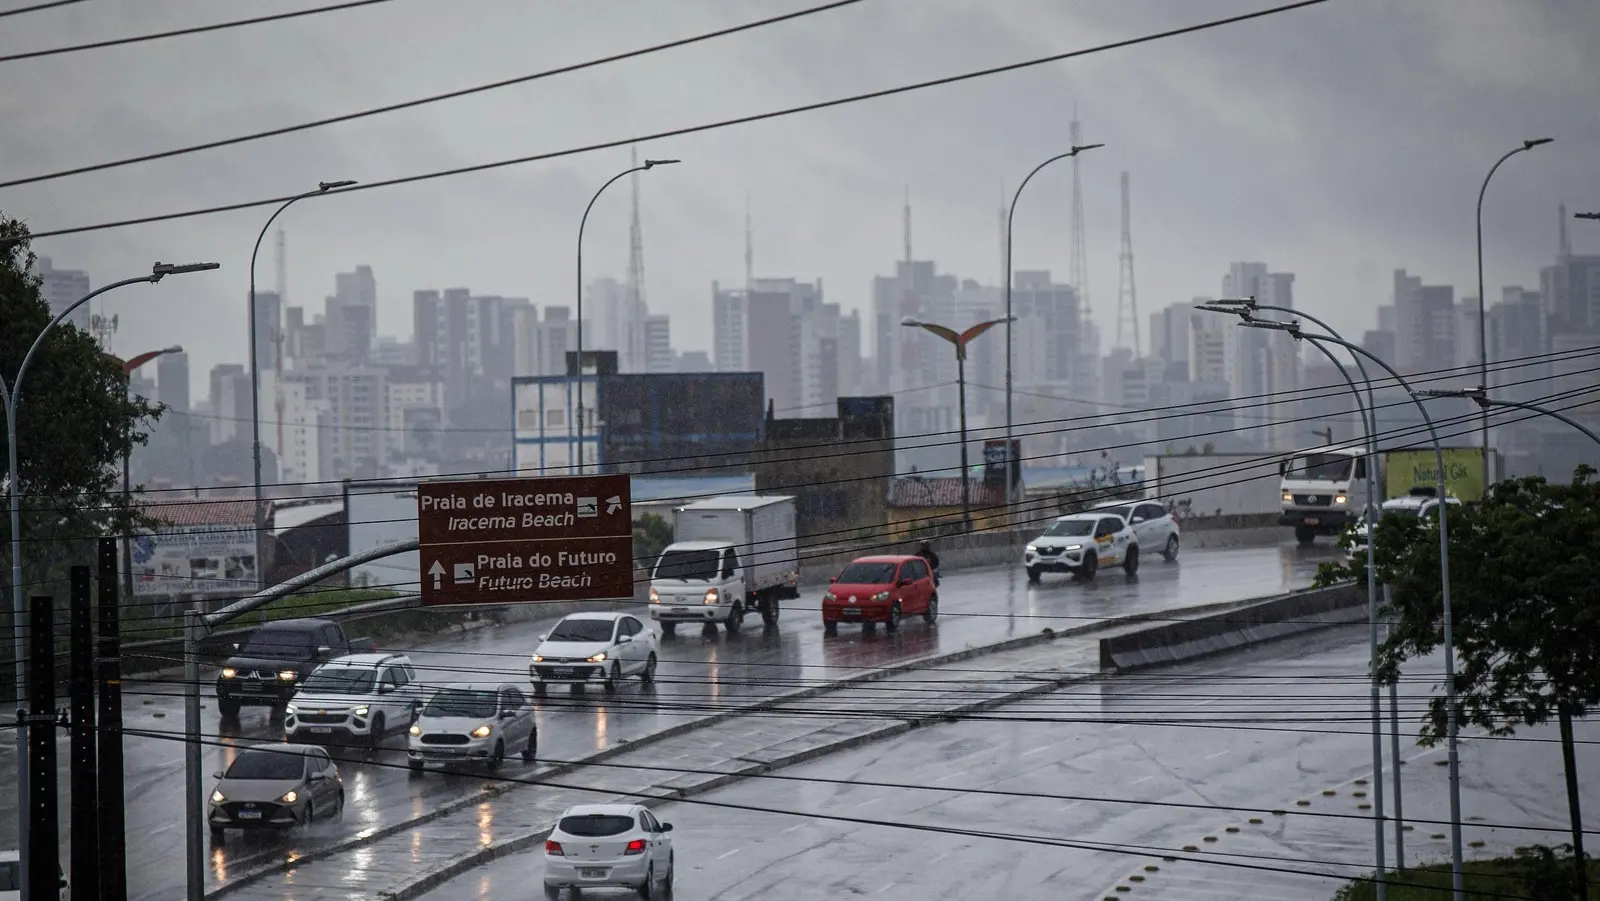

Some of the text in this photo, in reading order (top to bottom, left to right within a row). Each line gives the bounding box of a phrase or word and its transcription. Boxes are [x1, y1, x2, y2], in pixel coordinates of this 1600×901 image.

[421, 492, 574, 511] Praia de Iracema
[448, 512, 575, 531] Iracema Beach
[477, 550, 616, 570] Praia do Futuro
[478, 571, 592, 590] Futuro Beach
